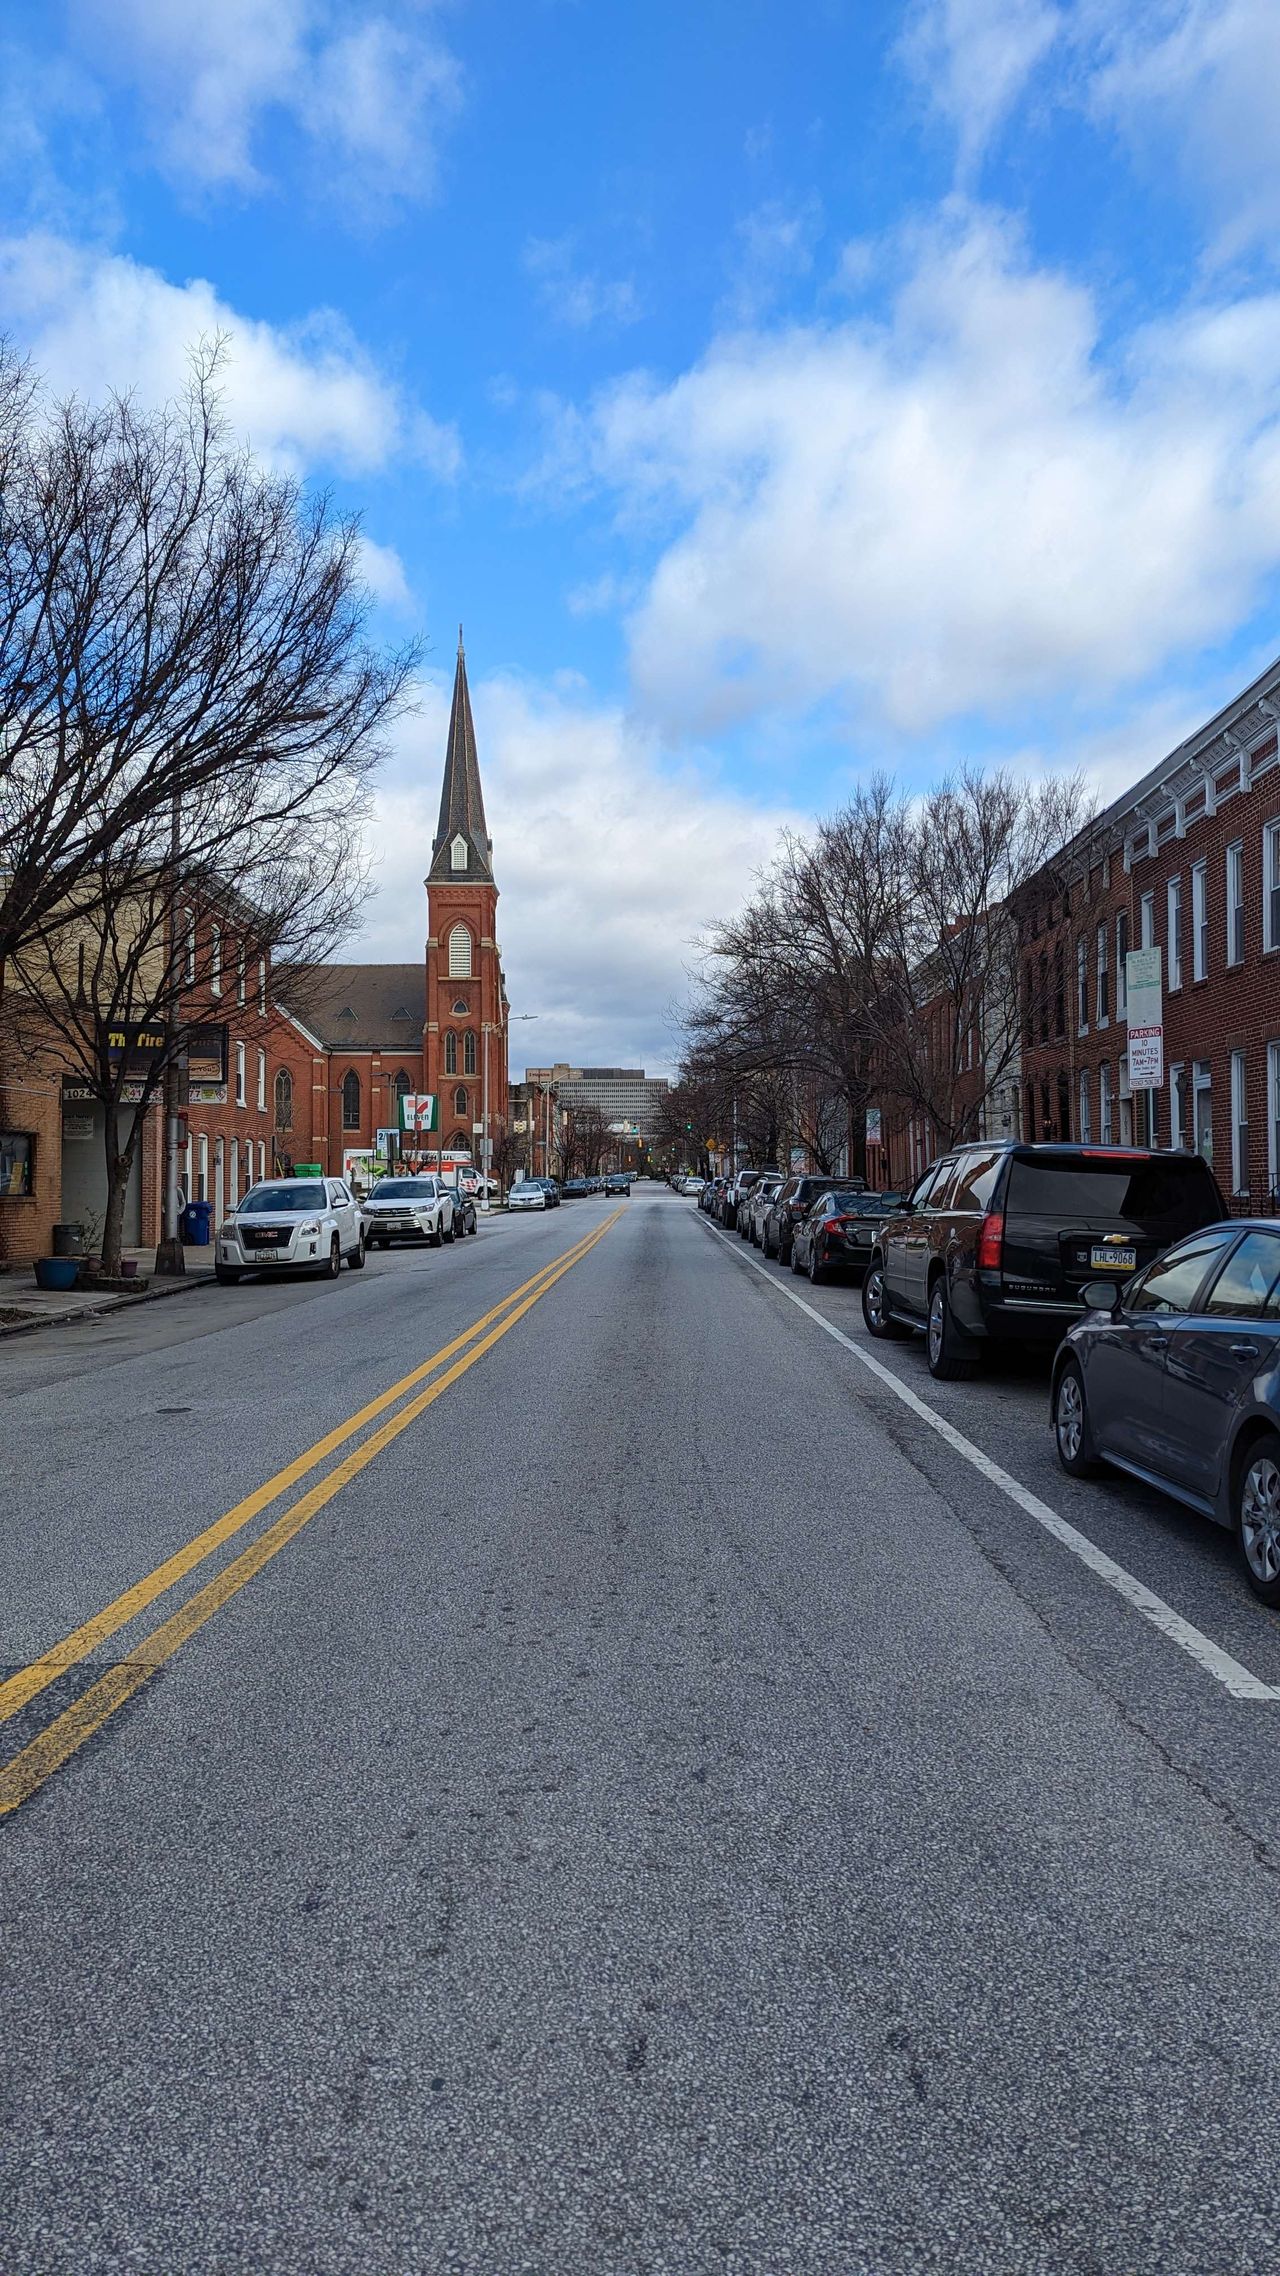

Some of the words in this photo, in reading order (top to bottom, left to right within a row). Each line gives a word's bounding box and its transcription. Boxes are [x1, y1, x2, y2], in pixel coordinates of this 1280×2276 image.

[1130, 1028, 1160, 1039] PARKING
[108, 1033, 130, 1047] Th
[1141, 1039, 1148, 1047] 10
[1131, 1048, 1159, 1057] MINUTES
[67, 1089, 93, 1099] 1024
